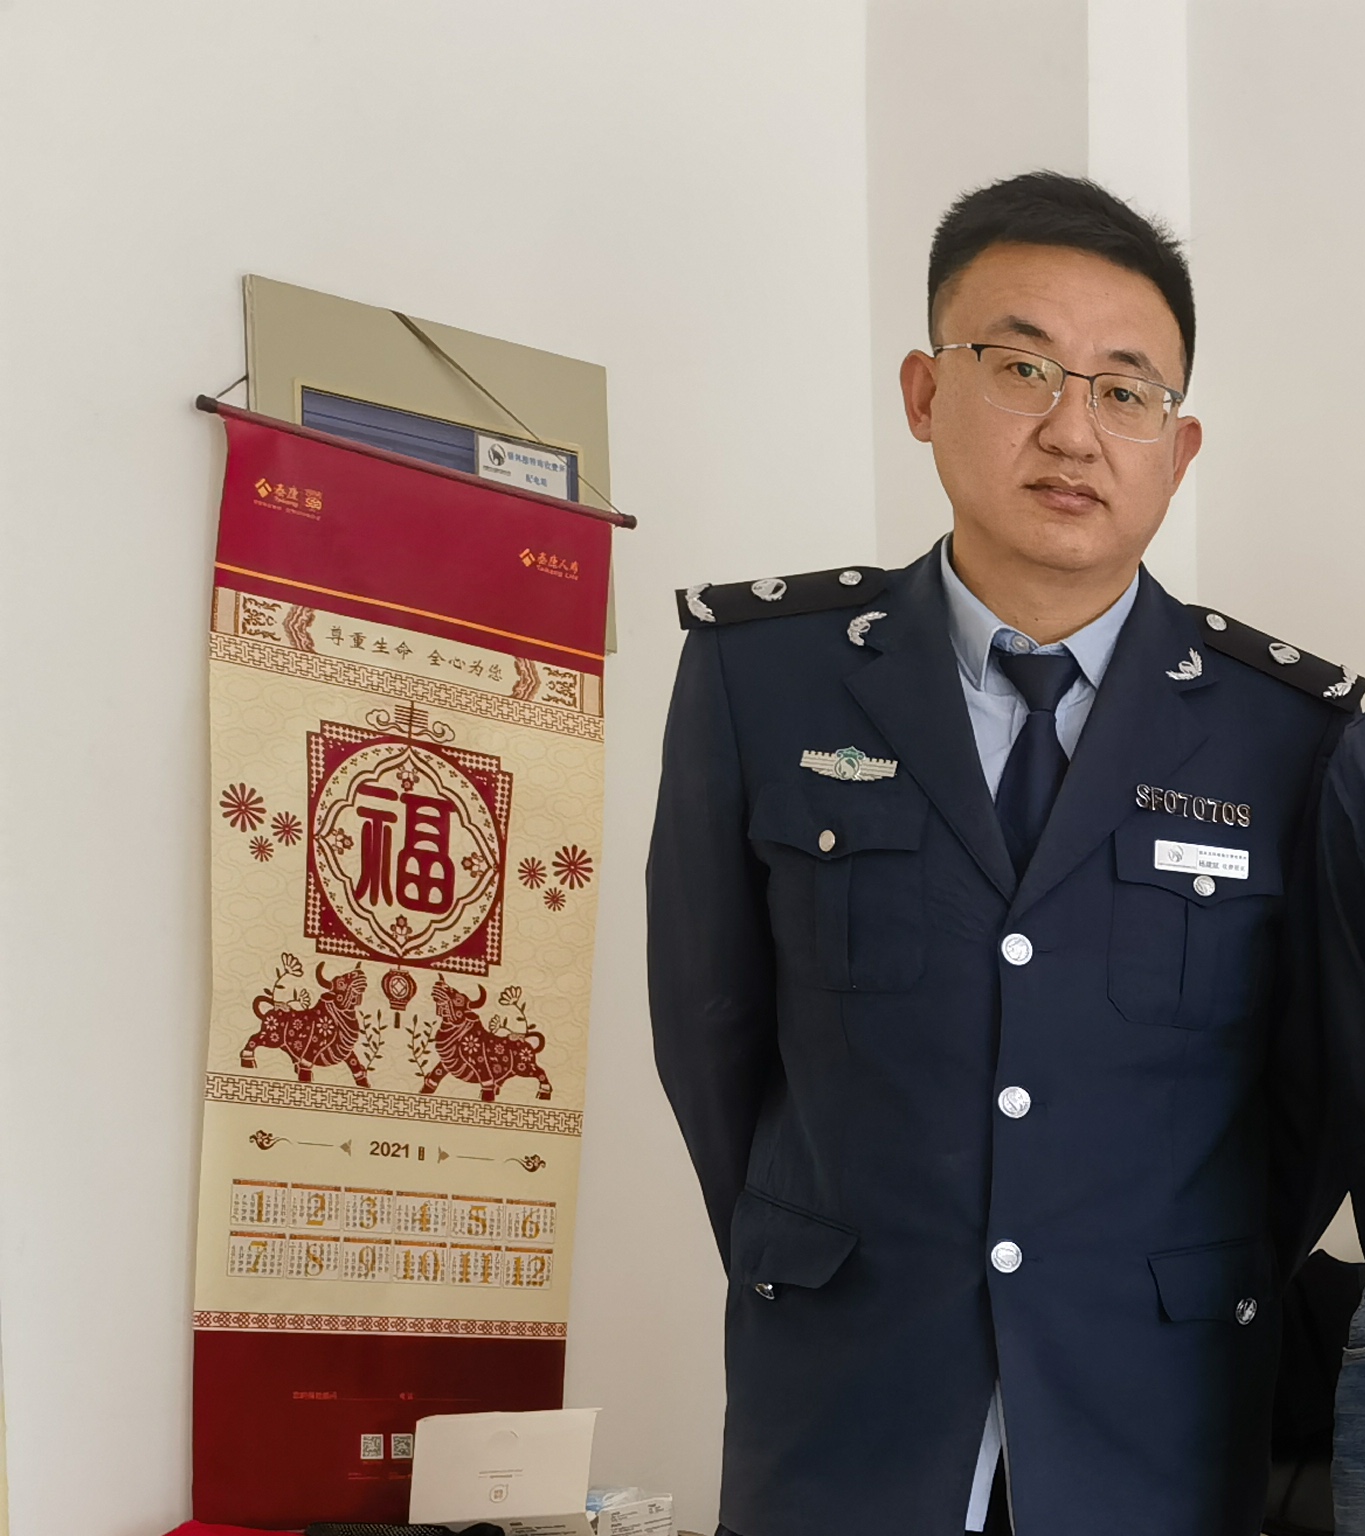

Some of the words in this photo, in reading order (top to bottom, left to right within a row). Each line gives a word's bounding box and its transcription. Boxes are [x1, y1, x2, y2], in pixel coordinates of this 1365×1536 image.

[325, 625, 413, 660] 尊重生命
[427, 649, 503, 682] 全心为您
[353, 782, 457, 915] 福
[369, 1141, 410, 1158] 2021
[255, 1190, 264, 1223] 1
[306, 1193, 326, 1226] 2
[359, 1196, 378, 1230] 3
[412, 1200, 431, 1233] 4
[468, 1205, 487, 1237] 5
[521, 1209, 540, 1239] 6
[249, 1240, 268, 1273] 7
[304, 1243, 324, 1277] 8
[359, 1245, 377, 1279] 9
[402, 1248, 441, 1281] 10
[461, 1252, 492, 1284] 11
[512, 1254, 549, 1287] 12
